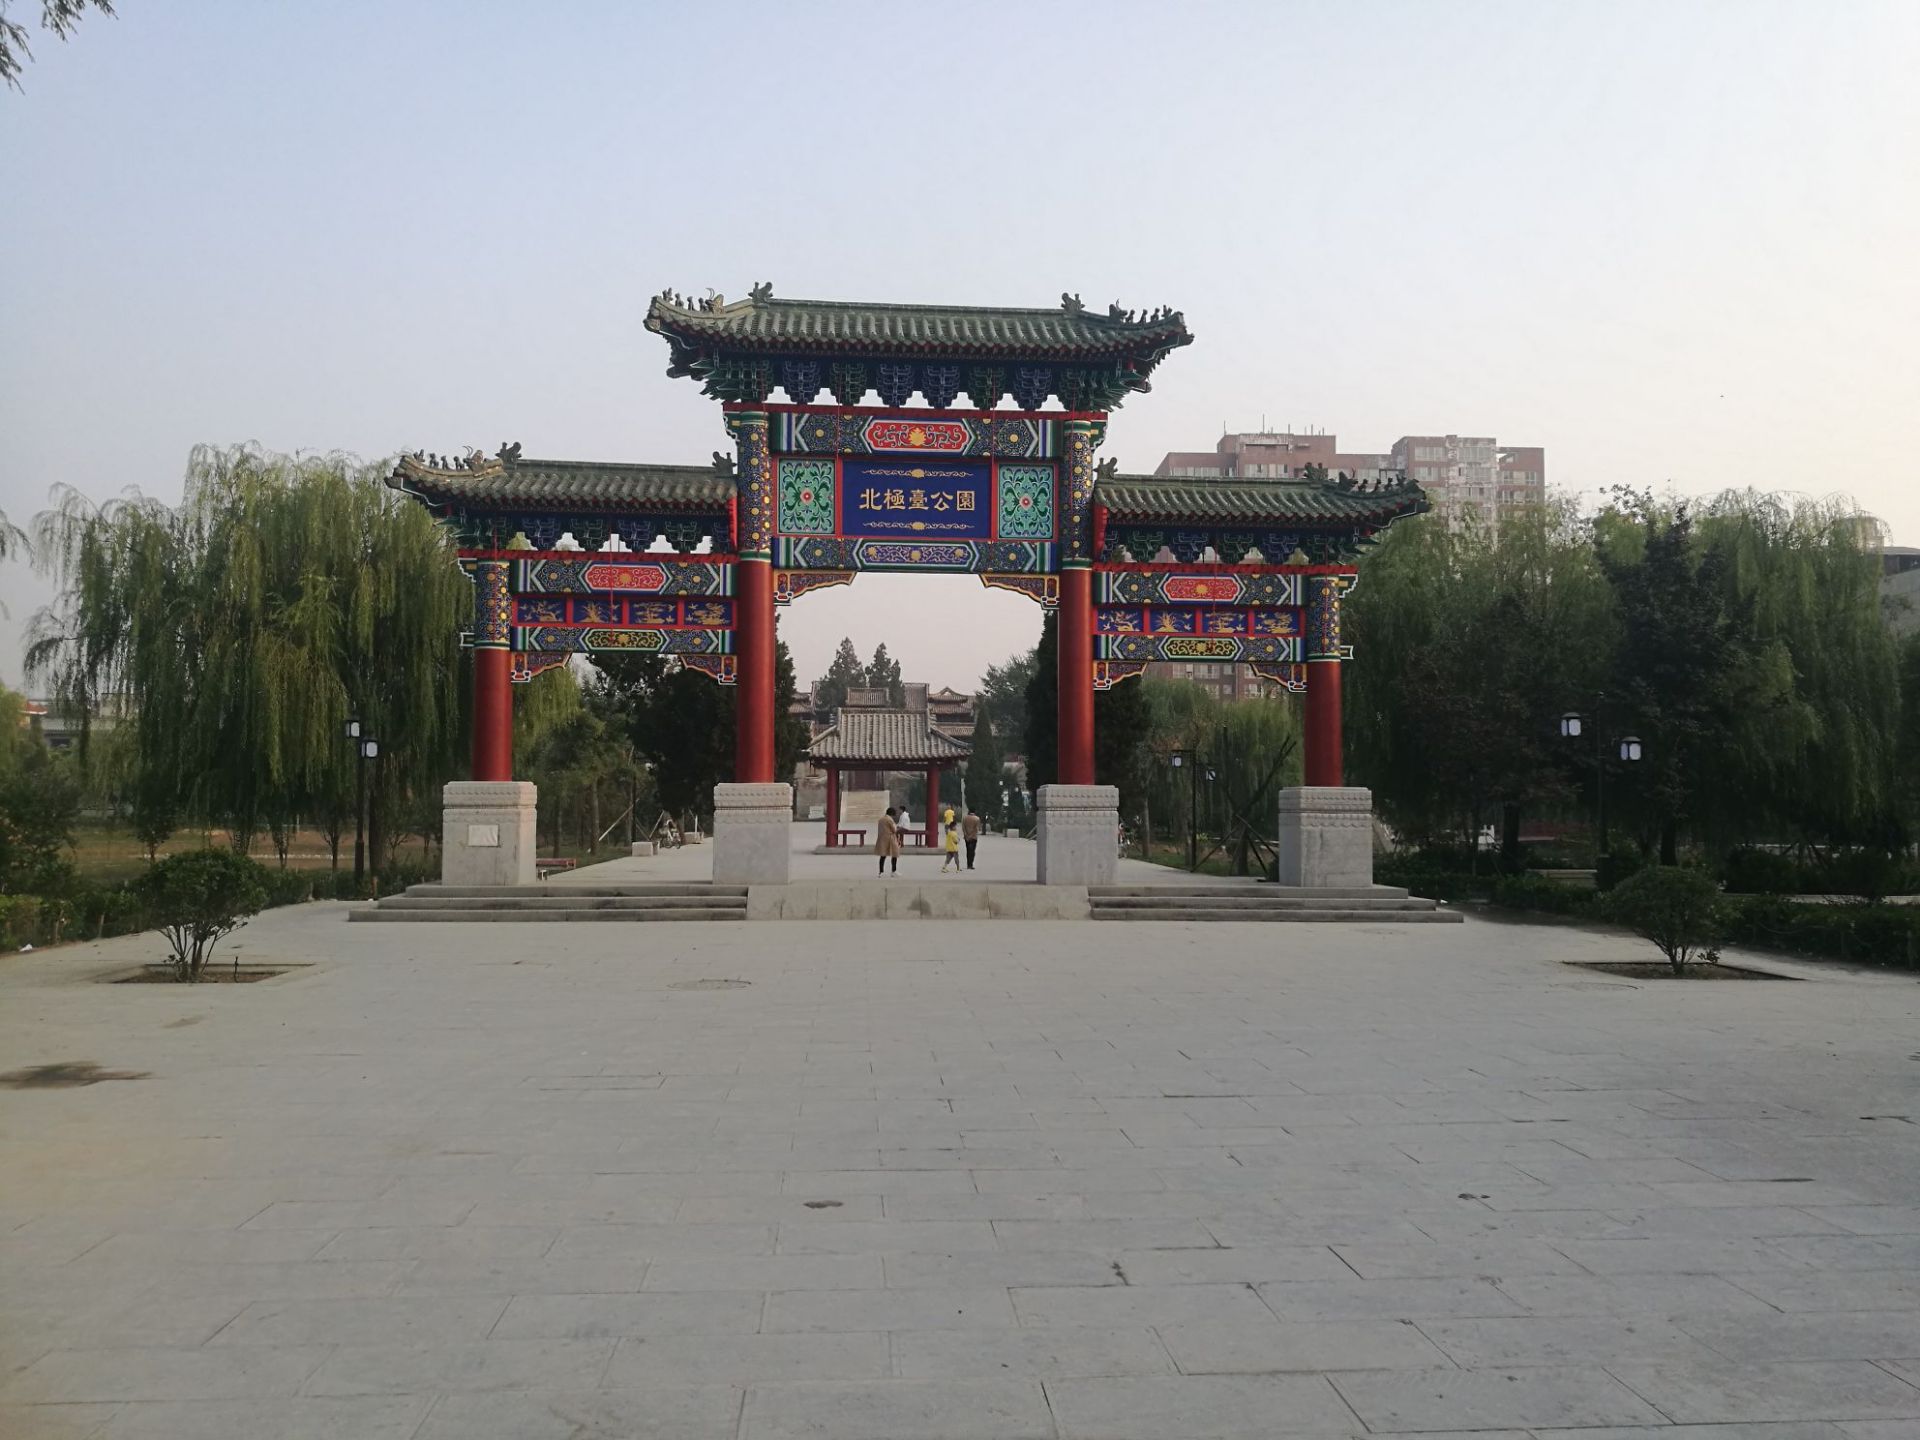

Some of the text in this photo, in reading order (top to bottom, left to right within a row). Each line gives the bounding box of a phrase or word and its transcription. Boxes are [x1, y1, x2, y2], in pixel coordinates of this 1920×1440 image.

[858, 487, 976, 512] 北極臺公園
